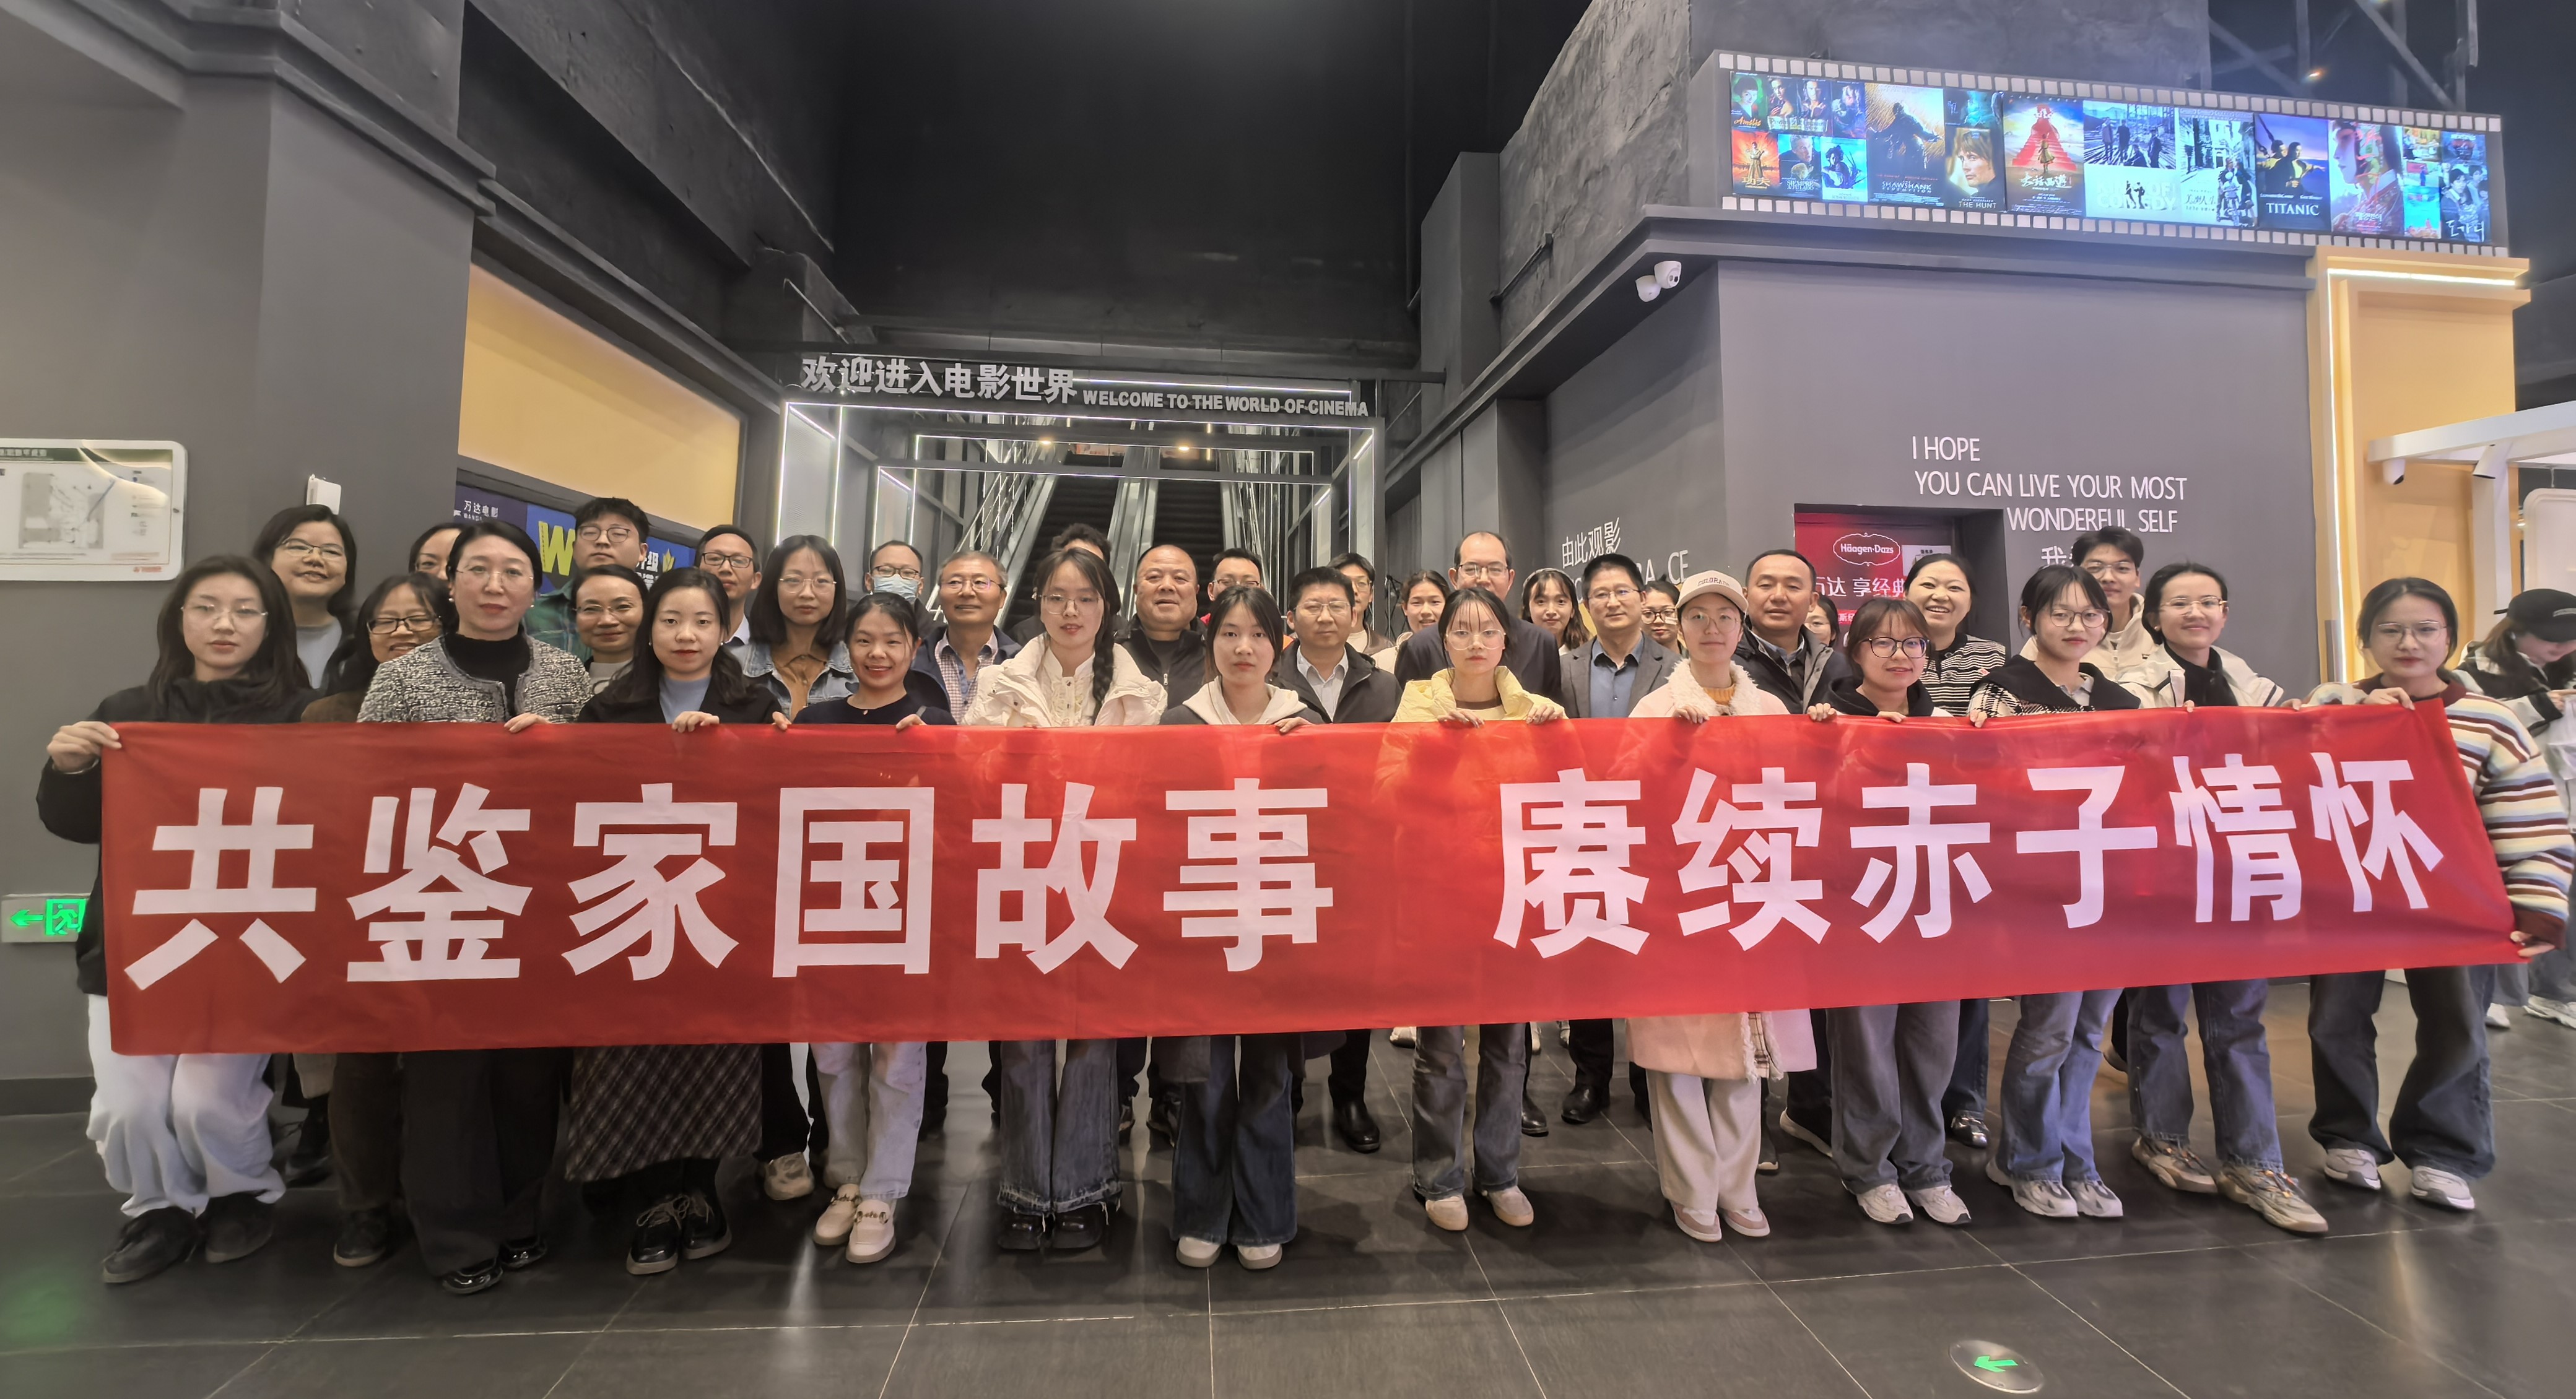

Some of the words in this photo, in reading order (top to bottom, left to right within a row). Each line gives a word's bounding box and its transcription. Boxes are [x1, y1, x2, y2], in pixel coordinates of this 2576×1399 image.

[1882, 180, 1932, 191] SHAWSHANK
[2266, 202, 2320, 215] TITANIC
[801, 355, 1077, 404] 欢迎进入电影世界
[1082, 390, 1164, 407] WELCOME
[1167, 394, 1188, 409] TO
[1191, 394, 1223, 410] THE
[1225, 396, 1281, 413] WORLD
[1284, 398, 1305, 414] OF
[1308, 399, 1369, 417] CINEMA
[1912, 435, 1917, 459] I
[1924, 436, 1981, 461] HOPE
[1914, 470, 1960, 495] YOU
[1967, 472, 2012, 496] CAN
[2019, 474, 2061, 498] LIVE
[2066, 474, 2123, 498] YOUR
[2131, 476, 2188, 500] MOST
[464, 500, 498, 518] 万达电影
[2006, 507, 2131, 532] WONDERFUL
[2138, 509, 2178, 533] SELF
[1562, 517, 1621, 569] 由此观影
[2041, 545, 2074, 568] 我
[124, 777, 1334, 990] 共鉴家国故事
[1493, 751, 2443, 959] 赓续赤子情怀
